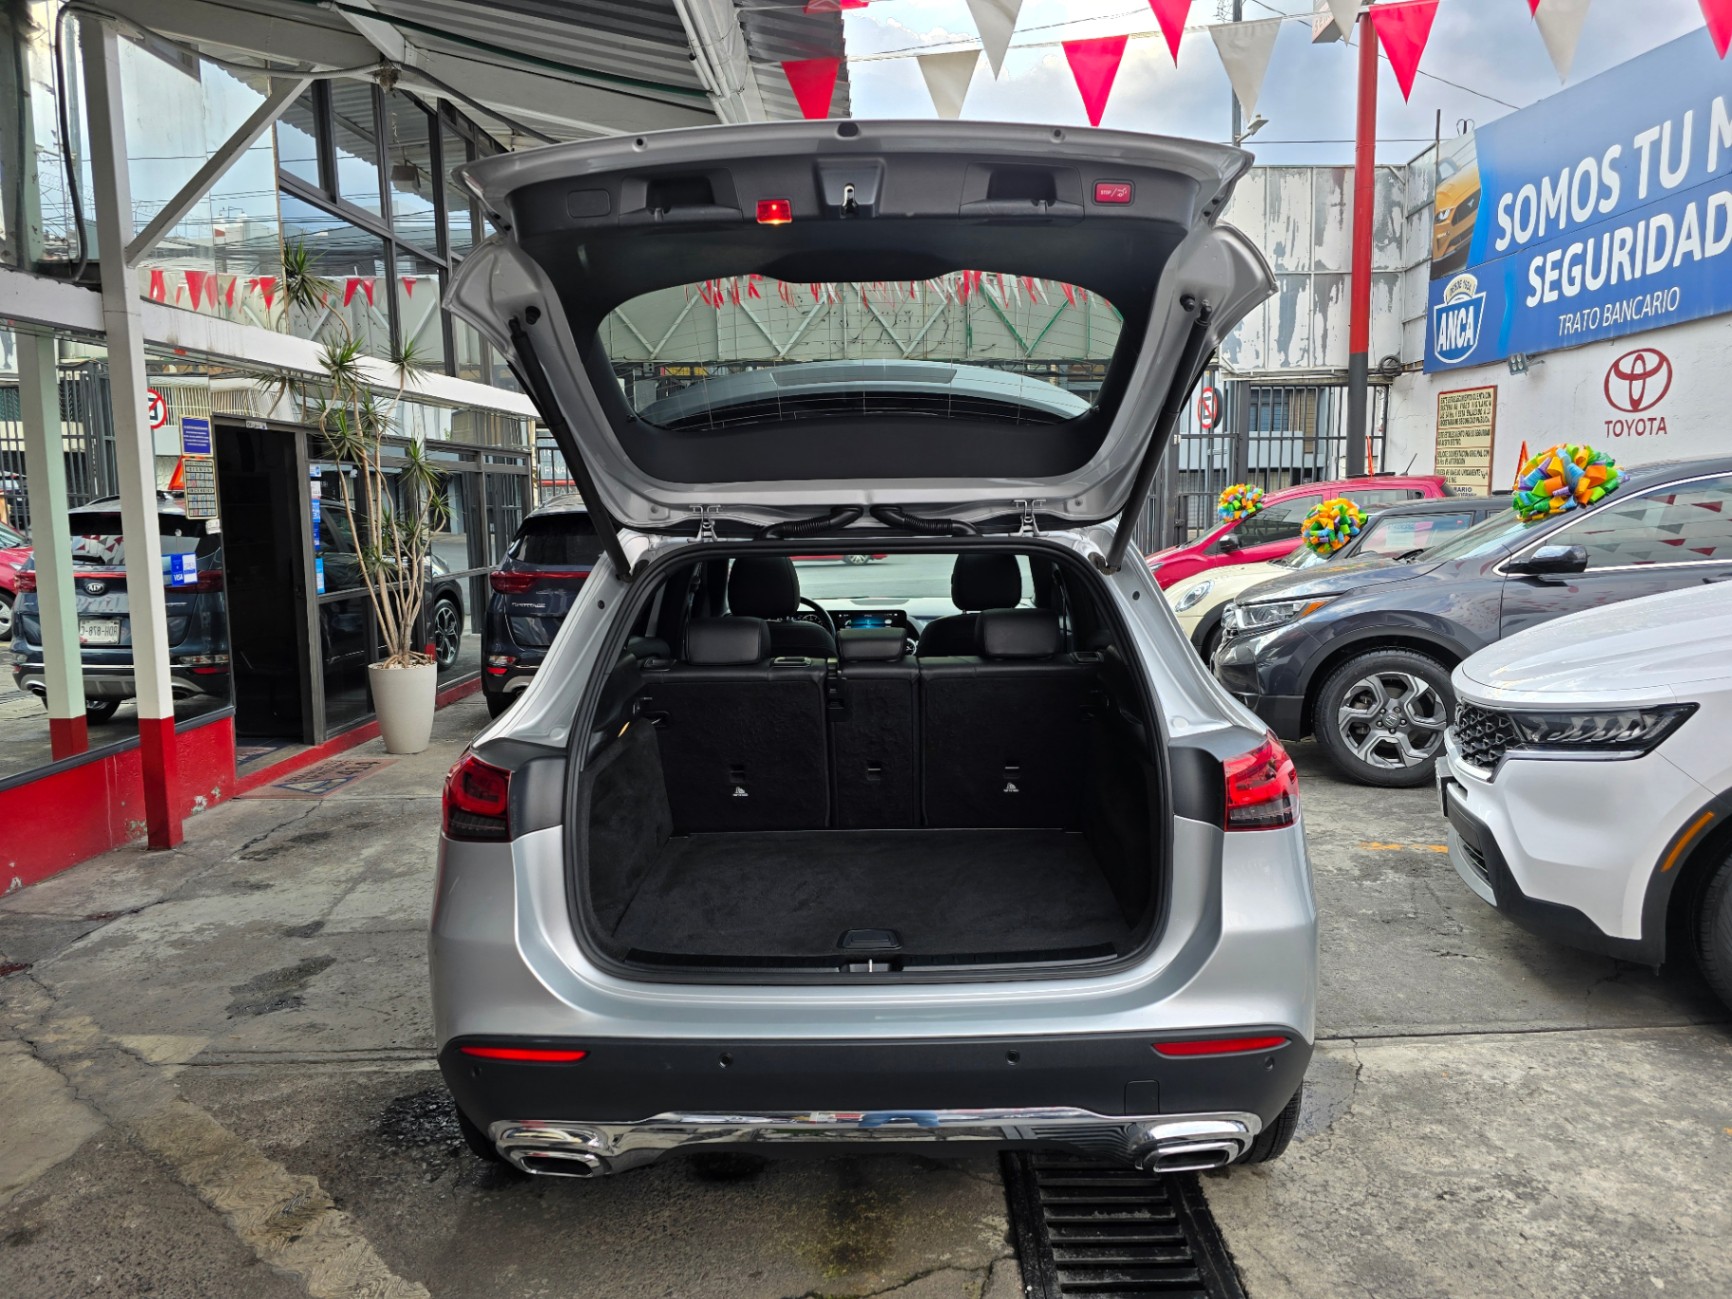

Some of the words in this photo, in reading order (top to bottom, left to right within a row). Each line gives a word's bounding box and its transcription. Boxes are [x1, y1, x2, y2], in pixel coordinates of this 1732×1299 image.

[1495, 144, 1622, 252] SOMOS
[1633, 109, 1694, 200] TU
[1526, 191, 1732, 308] SEGURIDAD
[1437, 305, 1475, 352] ANCA
[1558, 307, 1600, 336] TRATO
[1602, 286, 1680, 327] BANCARIO
[1604, 416, 1667, 438] TOYOTA
